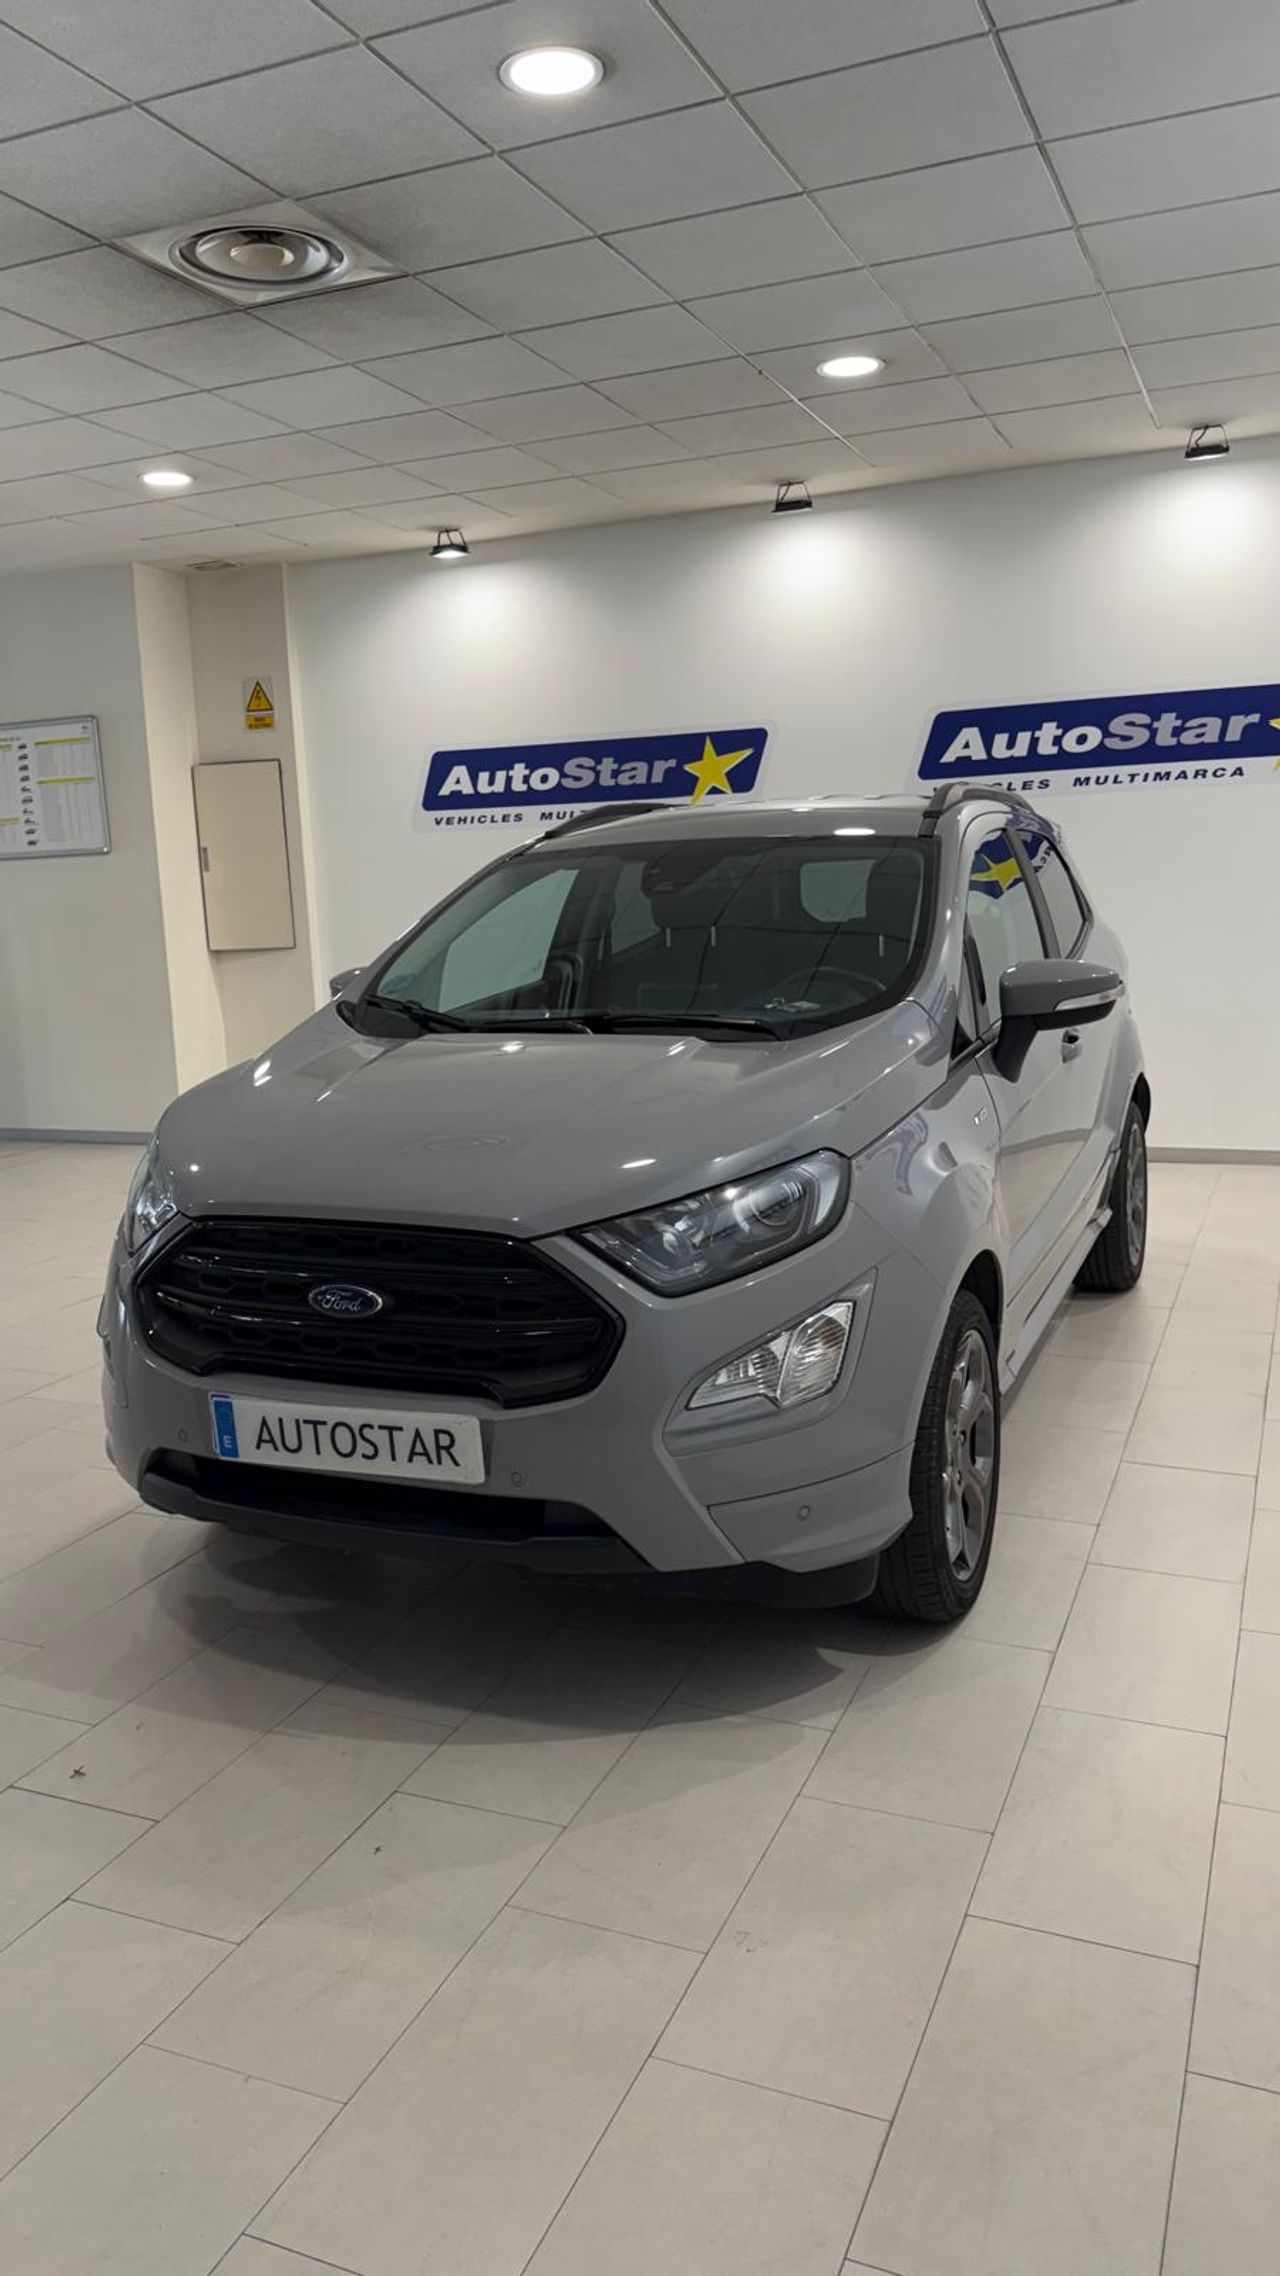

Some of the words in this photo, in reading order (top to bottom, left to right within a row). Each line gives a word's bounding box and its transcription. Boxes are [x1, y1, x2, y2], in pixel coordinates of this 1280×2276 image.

[939, 712, 1261, 764] AutoStar
[438, 756, 677, 797] AutoStar
[1072, 765, 1246, 788] MULTIMARCA
[434, 812, 524, 826] VEHICLES
[317, 1289, 363, 1312] Ford
[255, 1415, 462, 1468] AUTOSTAR
